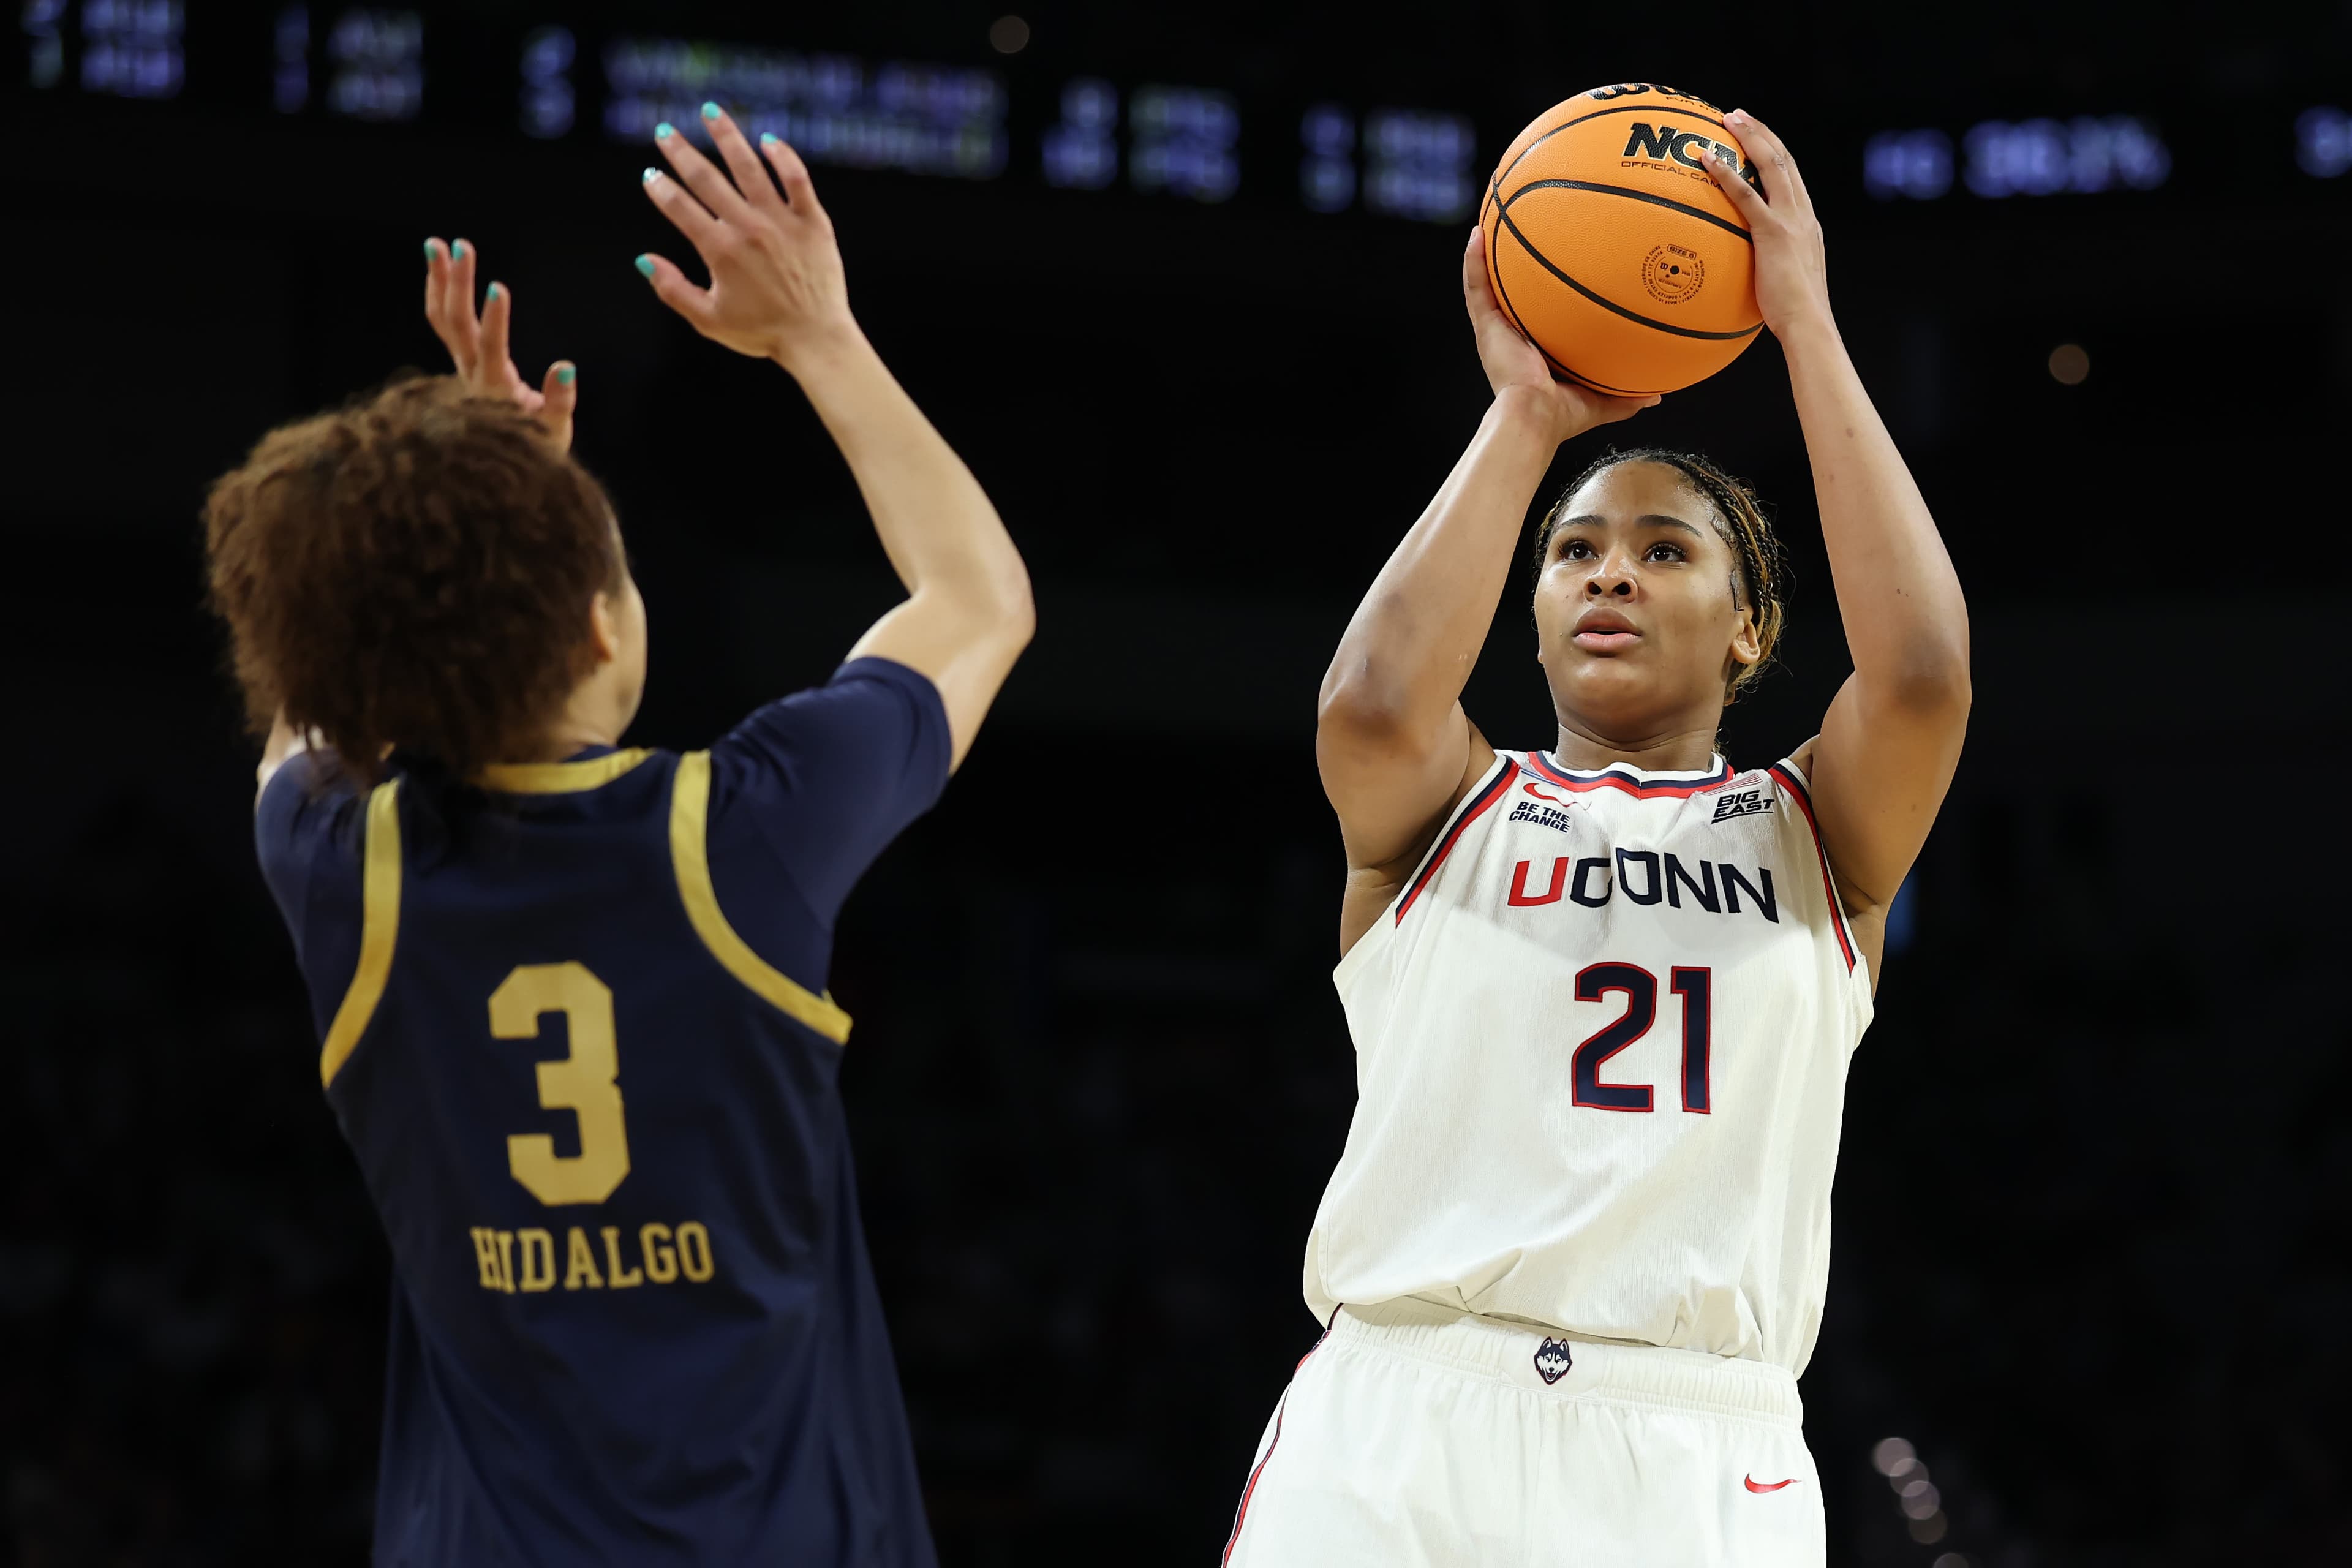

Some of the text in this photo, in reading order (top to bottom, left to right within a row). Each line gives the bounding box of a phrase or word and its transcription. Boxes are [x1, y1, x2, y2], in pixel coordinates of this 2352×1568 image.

[1621, 160, 1725, 192] OFFICIAL GAM
[1517, 801, 1570, 824] BE THE
[1713, 799, 1775, 818] EAST
[1717, 790, 1760, 808] BIG
[1509, 810, 1570, 834] CHANGE
[1507, 847, 1779, 924] UCONN
[1572, 961, 1711, 1114] 21
[488, 960, 631, 1207] 3
[470, 1221, 715, 1294] HIDALGO
